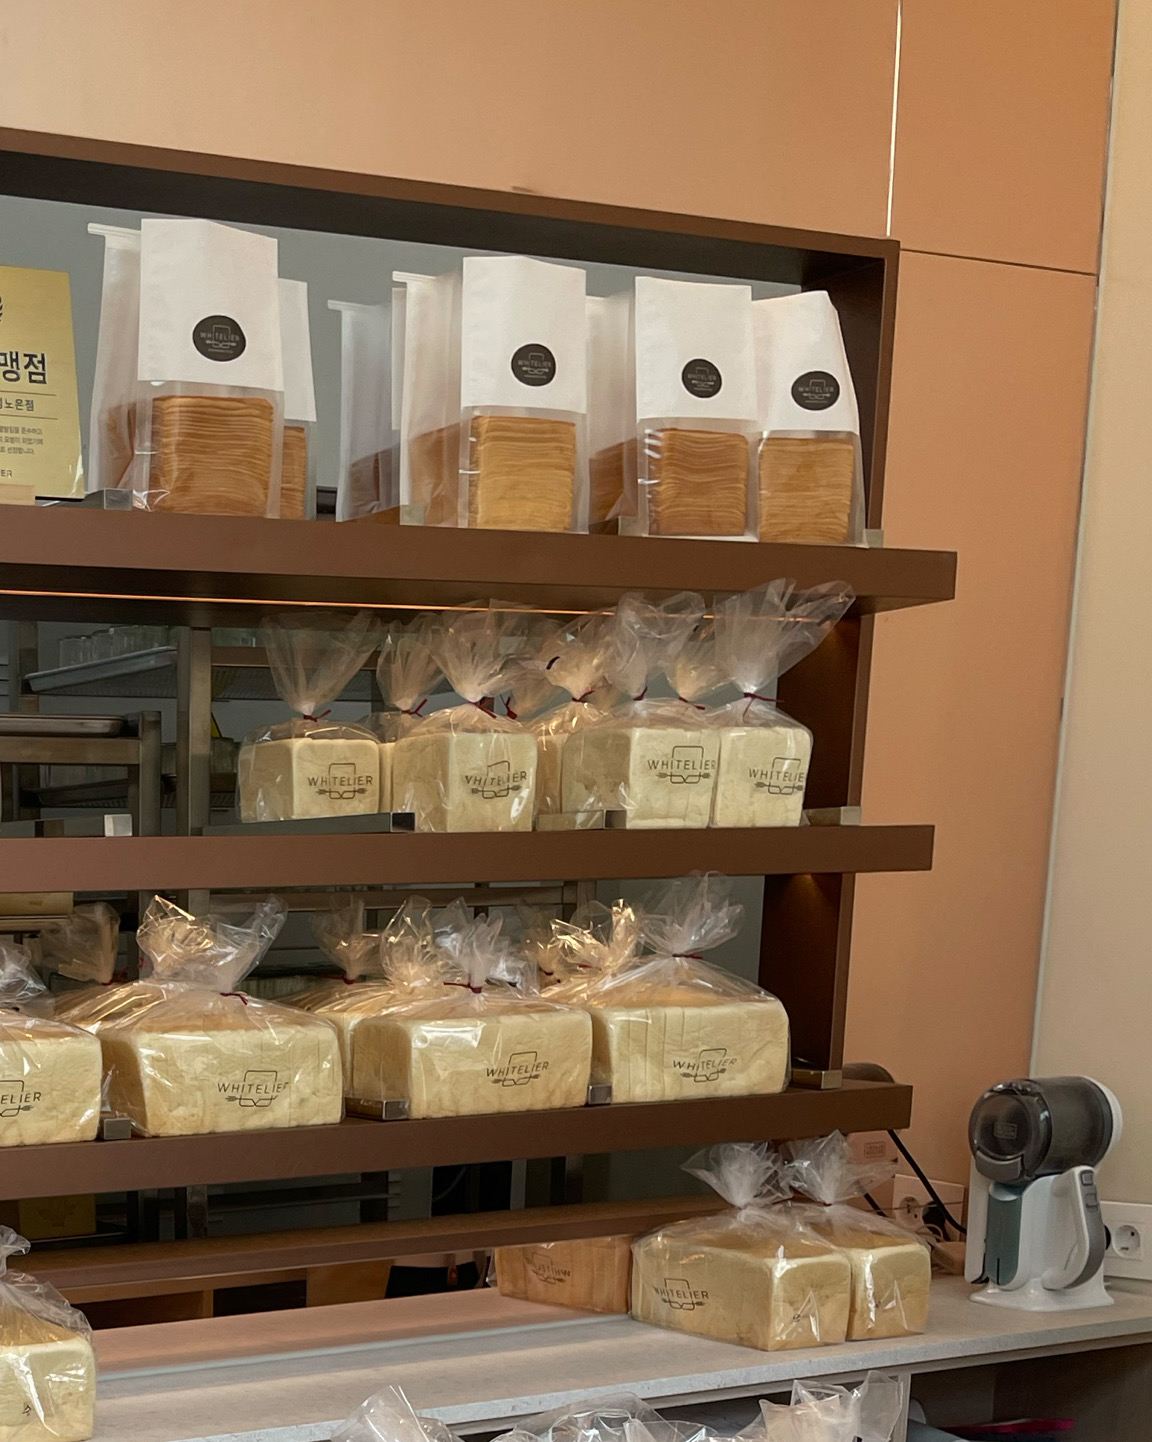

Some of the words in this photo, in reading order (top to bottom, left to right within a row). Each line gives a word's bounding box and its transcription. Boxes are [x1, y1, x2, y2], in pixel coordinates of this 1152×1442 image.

[647, 759, 717, 771] WHITELIER
[307, 775, 373, 787] WHITELIER
[749, 768, 805, 783] WHITELIE
[486, 1061, 550, 1078] WHITELIER
[673, 1056, 738, 1071] WHITELIER
[653, 1285, 709, 1300] WHITELIER
